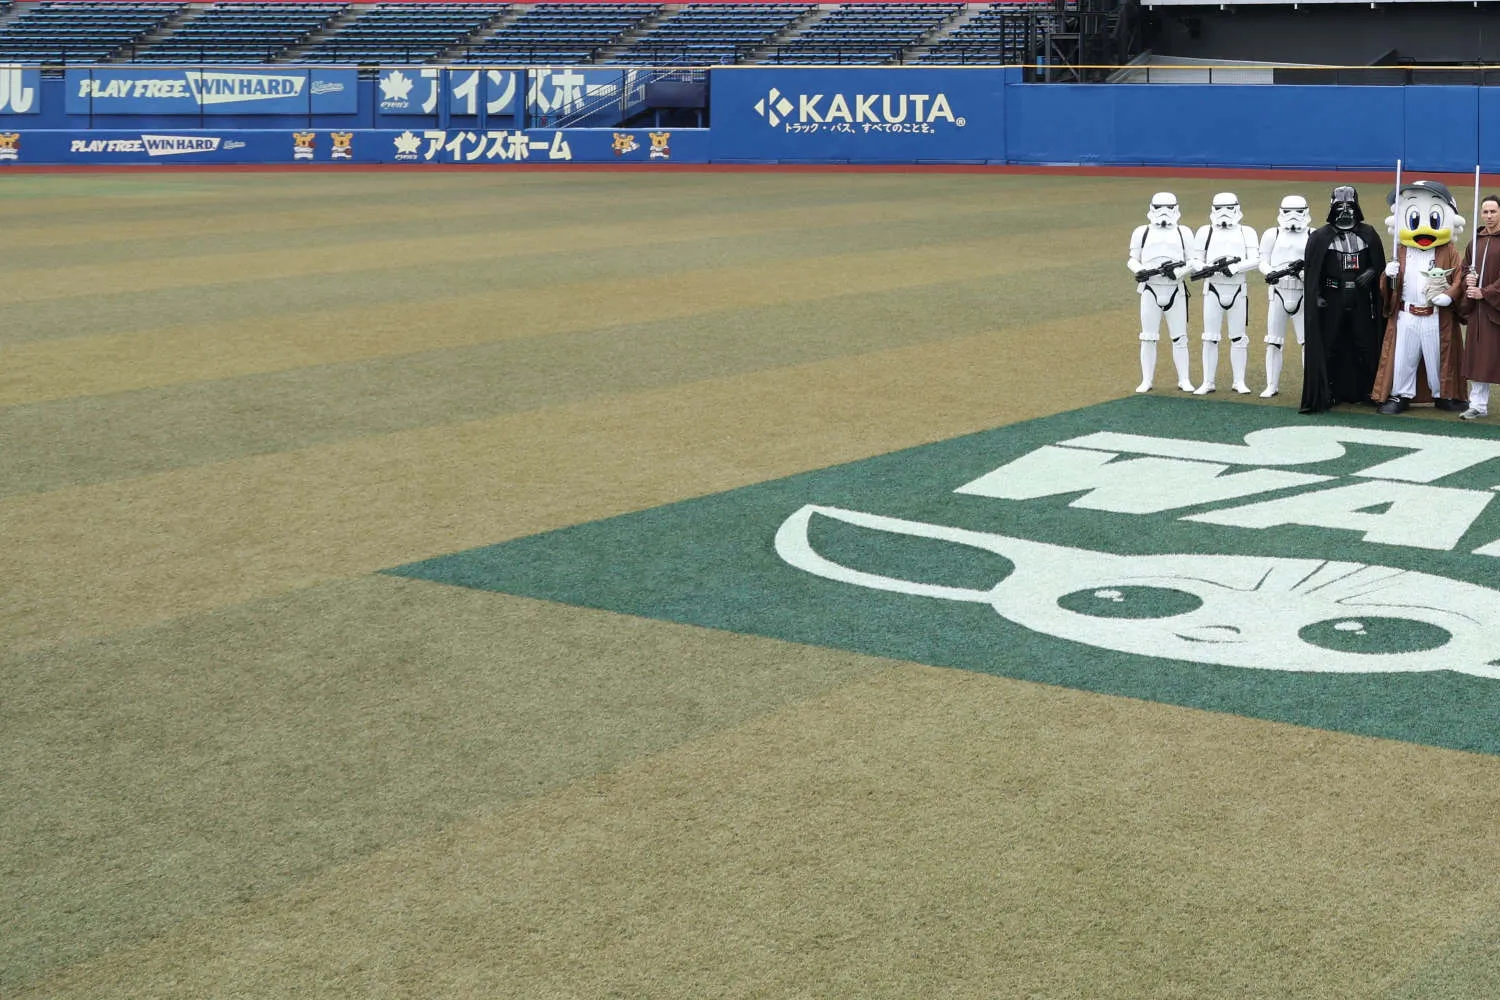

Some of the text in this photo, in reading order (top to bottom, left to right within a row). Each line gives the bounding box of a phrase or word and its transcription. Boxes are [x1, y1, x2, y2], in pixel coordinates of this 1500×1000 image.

[78, 79, 128, 98] PLAY
[131, 79, 191, 98] FREE.
[193, 78, 237, 97] WIN
[239, 78, 299, 96] HARD.
[799, 93, 955, 122] KAKUTA
[71, 140, 107, 153] PLAY
[111, 140, 145, 153] FREE.
[147, 139, 173, 151] WIN
[175, 139, 216, 151] HARD.
[424, 130, 572, 161] アインズホーム
